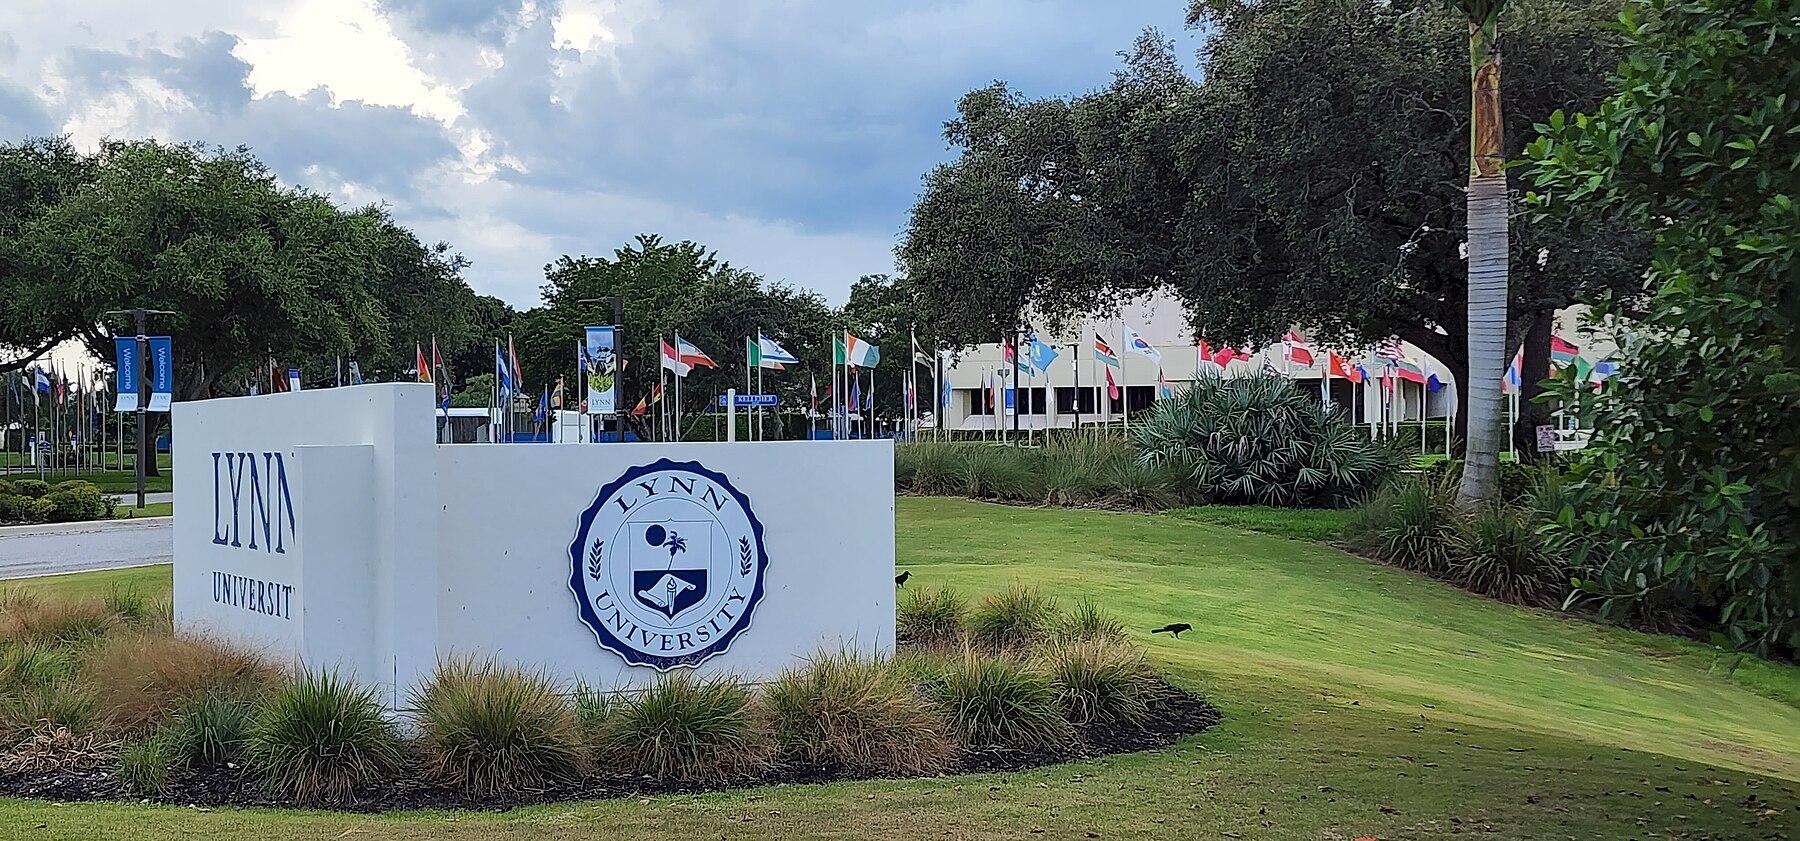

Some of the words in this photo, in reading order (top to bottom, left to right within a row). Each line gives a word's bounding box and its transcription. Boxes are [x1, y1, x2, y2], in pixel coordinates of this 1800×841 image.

[123, 348, 132, 390] Welcome
[158, 347, 166, 389] Welcome
[211, 452, 296, 554] LYNN
[613, 475, 730, 515] LYNN
[212, 571, 296, 620] UNIVERSIT
[595, 586, 746, 651] UNIVERSITY
